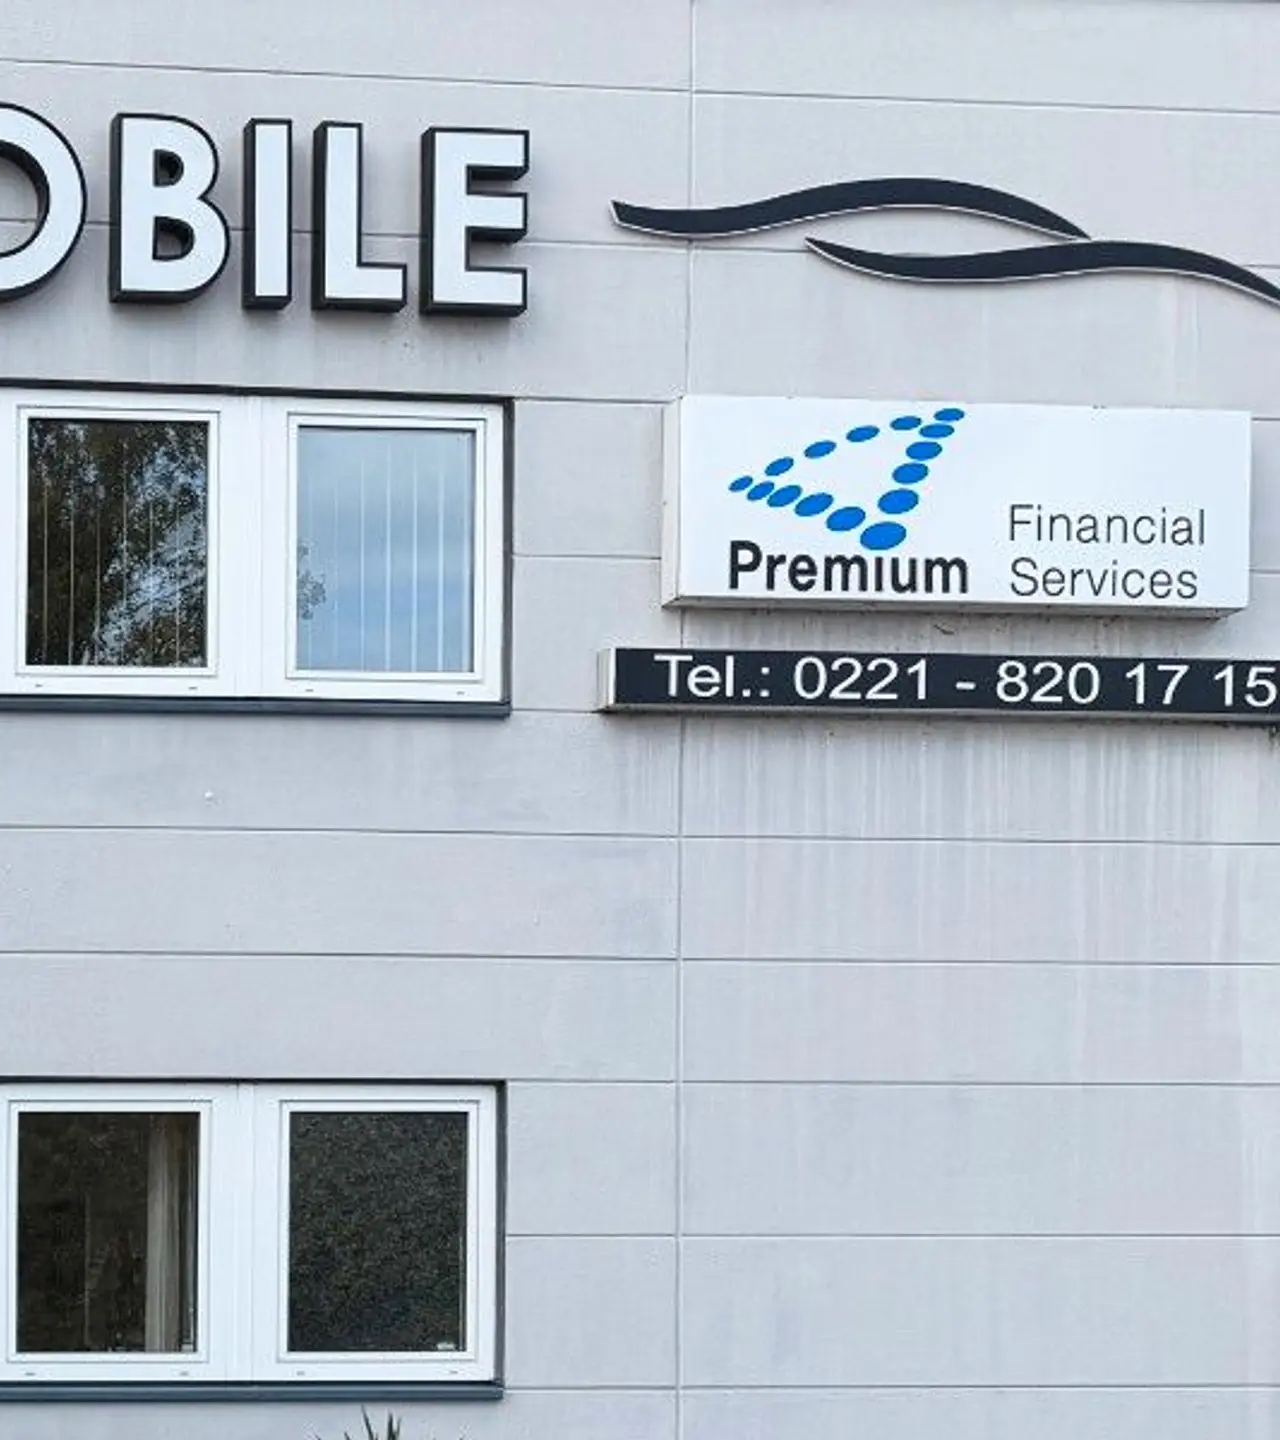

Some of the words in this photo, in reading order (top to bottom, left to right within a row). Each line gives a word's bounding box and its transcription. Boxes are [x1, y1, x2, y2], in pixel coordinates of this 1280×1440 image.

[1009, 504, 1205, 546] Financial
[728, 540, 969, 594] Premium
[1009, 557, 1199, 600] Services
[654, 653, 772, 699] Tel.:
[794, 656, 928, 702] 0221
[996, 660, 1100, 705] 820
[1126, 664, 1189, 704] 17
[1214, 664, 1278, 708] 15
